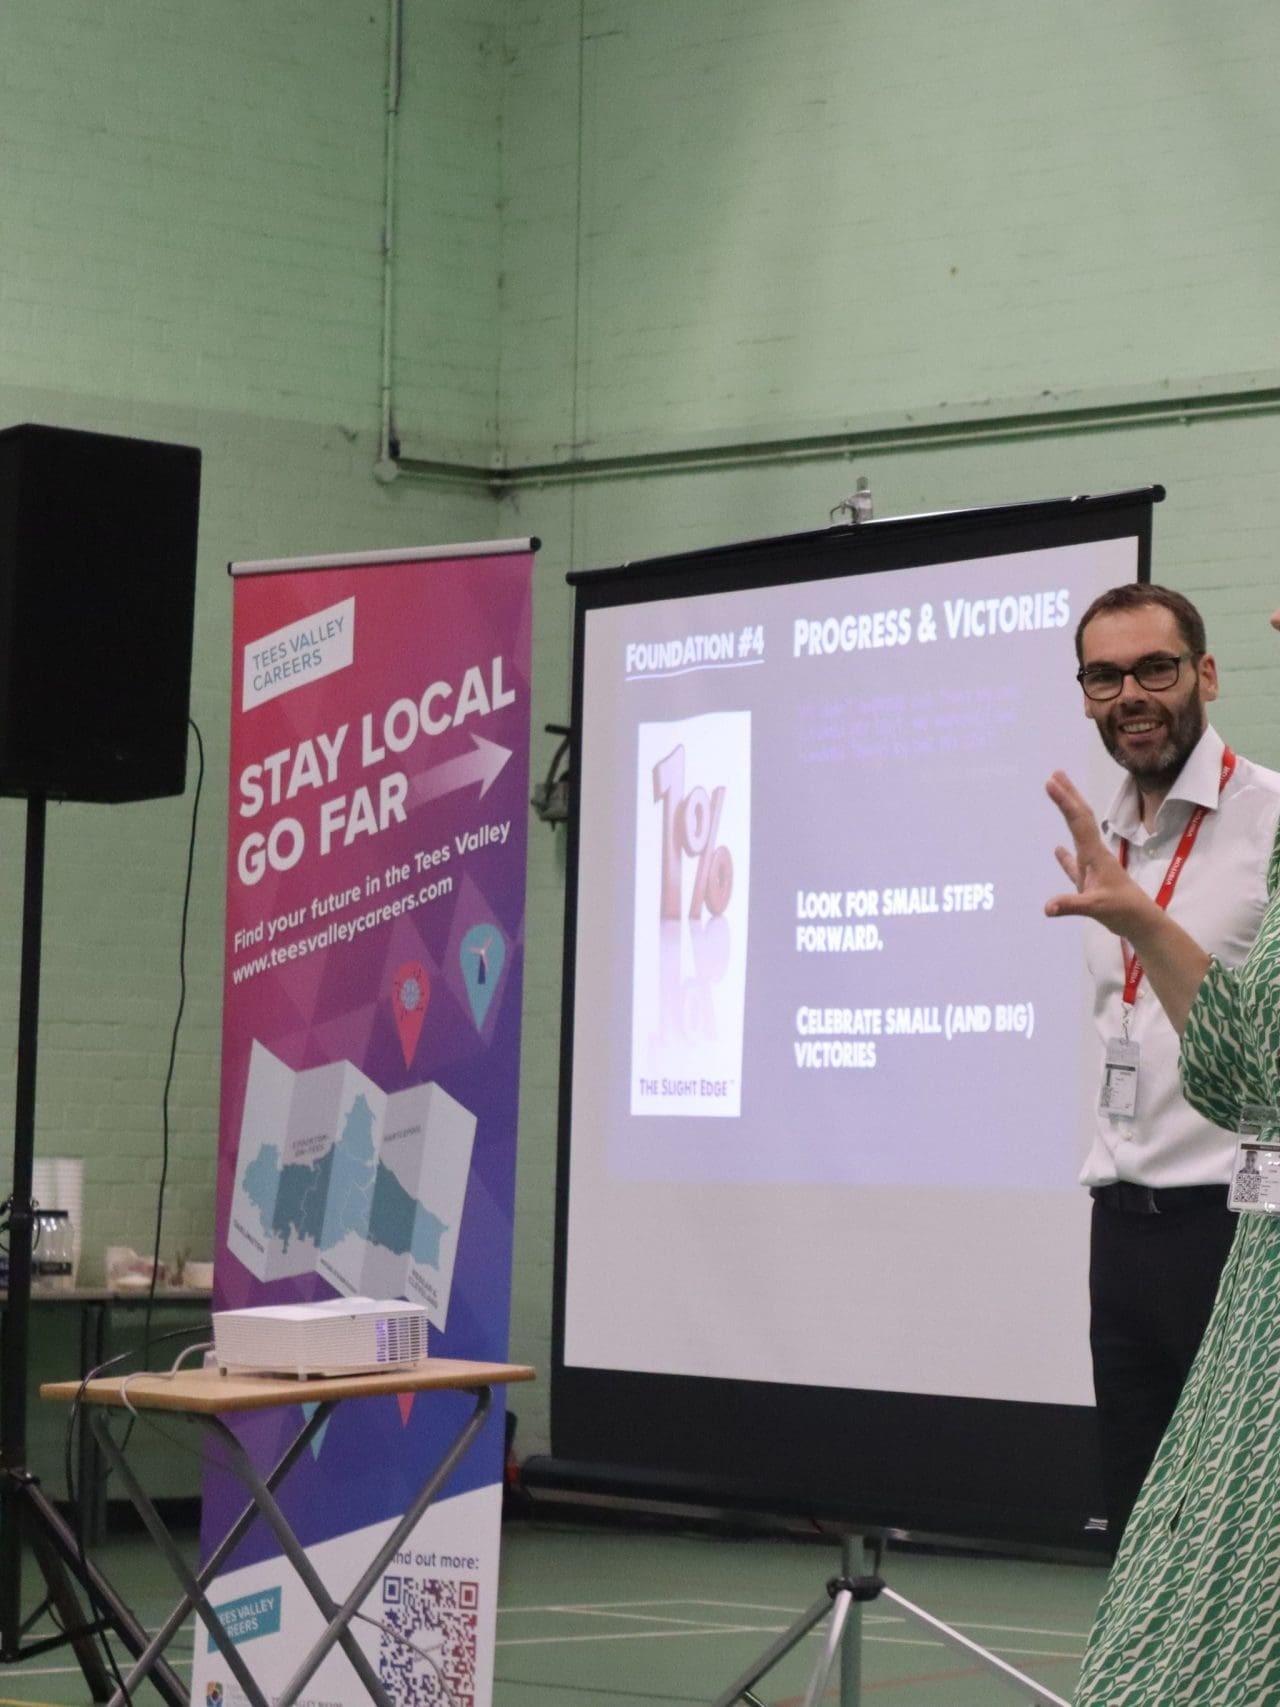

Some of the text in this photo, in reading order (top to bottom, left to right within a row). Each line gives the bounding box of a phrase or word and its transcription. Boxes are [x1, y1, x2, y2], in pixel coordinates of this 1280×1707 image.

[252, 616, 344, 671] TEES VALLEY
[794, 589, 1071, 657] PROGRESS & VICTORIES
[625, 624, 765, 673] FOUNDATION #4
[253, 648, 323, 692] CAREERS
[239, 656, 516, 818] STAY LOCAL
[237, 772, 409, 886] GO FAR
[234, 821, 511, 954] Find your future in the Tees Valley
[797, 882, 995, 919] LOOK FOR SMALL STEPS
[232, 876, 453, 985] www.teesvalleycareers.com
[796, 923, 884, 953] FORWARD.
[796, 1001, 1035, 1041] CELEBRATE SMALL (AND BIG)
[794, 1040, 877, 1069] VICTORIES
[640, 1078, 658, 1097] THE
[661, 1078, 697, 1097] SLIGHT
[392, 1550, 479, 1570] nd out more:
[217, 1597, 275, 1627] EES VALLEY
[226, 1617, 259, 1638] REERS
